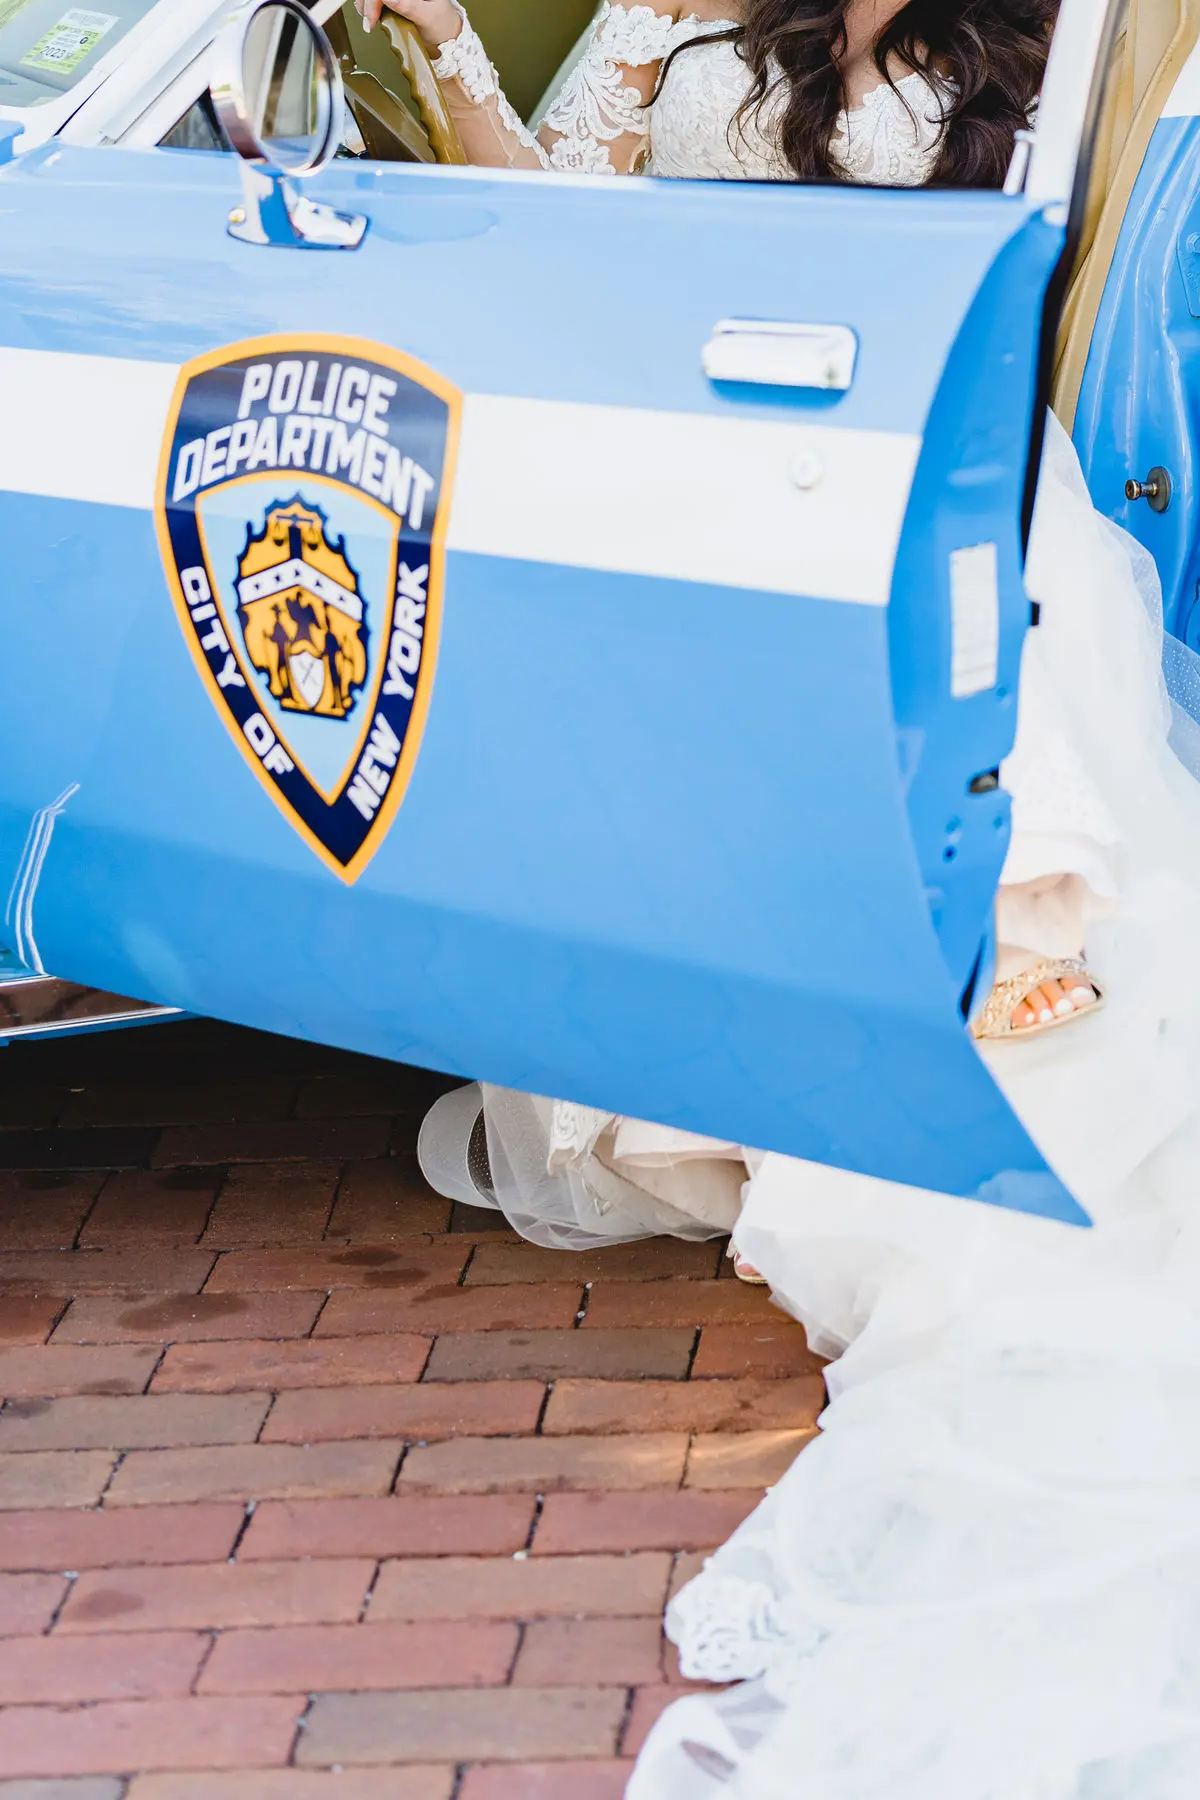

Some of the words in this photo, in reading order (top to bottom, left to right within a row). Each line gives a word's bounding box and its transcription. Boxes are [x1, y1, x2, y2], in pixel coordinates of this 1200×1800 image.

[39, 45, 67, 59] 2023
[237, 359, 398, 438] POLICE
[172, 413, 435, 531] DEPARTMENT
[179, 565, 246, 688] CITY
[242, 712, 296, 775] OF
[346, 711, 401, 822] NEW
[382, 560, 429, 700] YORK
